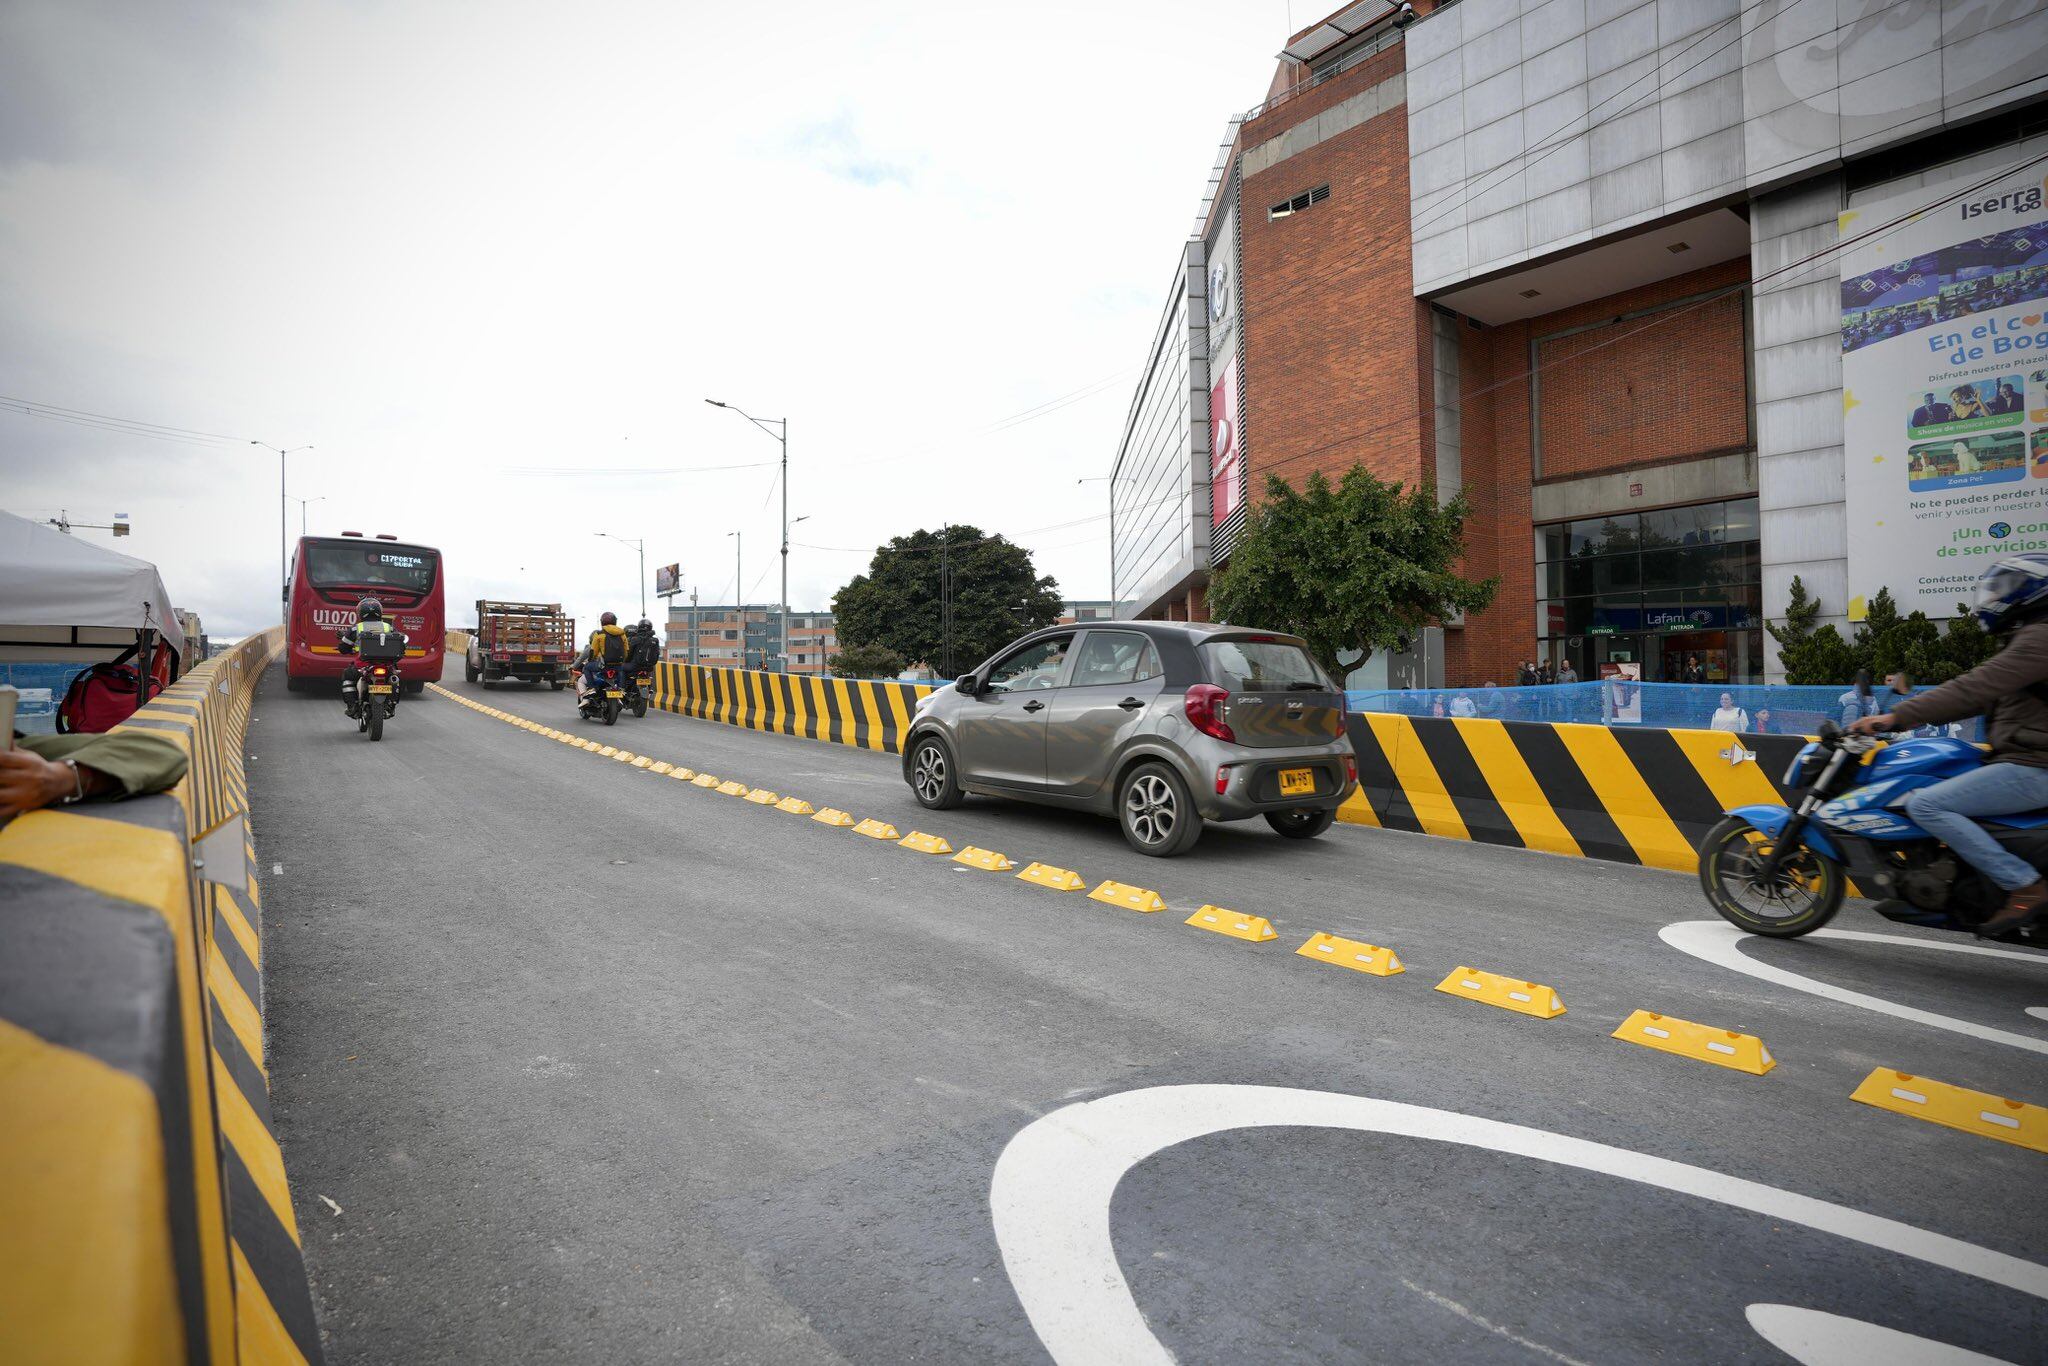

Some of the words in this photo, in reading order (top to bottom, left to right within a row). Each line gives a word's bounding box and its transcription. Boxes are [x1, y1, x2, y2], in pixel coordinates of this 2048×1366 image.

[1961, 187, 2041, 220] Iserra
[2013, 200, 2042, 214] 100
[1928, 332, 1963, 353] En
[1971, 317, 1999, 340] el
[1950, 346, 1984, 365] de
[1928, 369, 1969, 382] Disfruta
[1971, 363, 2011, 374] nuestra
[1947, 477, 1968, 485] Zona
[1969, 475, 1983, 483] Pet
[1910, 500, 1926, 509] No
[1929, 498, 1942, 507] te
[1945, 494, 1989, 507] puedes
[1993, 488, 2036, 502] perder
[1915, 510, 1942, 520] venir
[1943, 509, 1953, 519] y
[1954, 505, 1991, 516] visitar
[1994, 500, 2041, 512] nuestra
[1936, 546, 1958, 557] de
[1963, 539, 2048, 555] servicios
[1918, 574, 1975, 585] Conéctate
[1918, 585, 1969, 594] nosotros
[313, 609, 357, 625] U1070
[1647, 612, 1685, 625] Lafam
